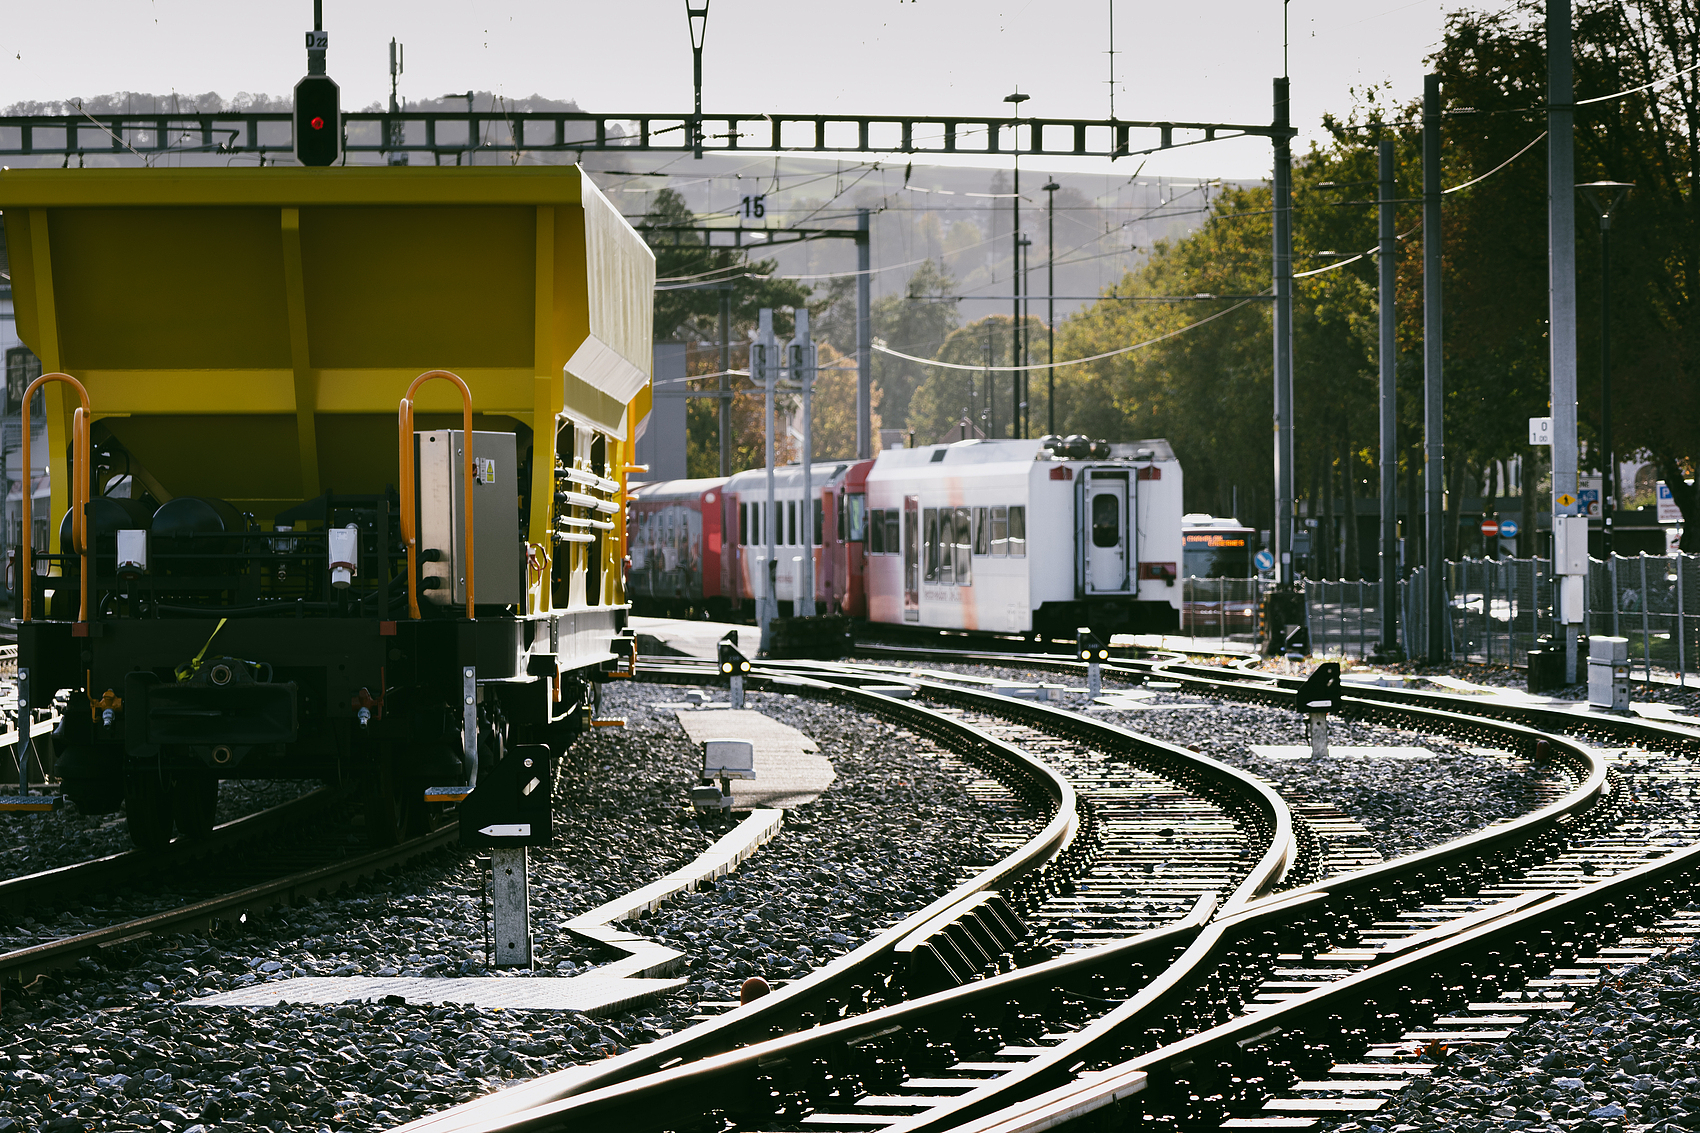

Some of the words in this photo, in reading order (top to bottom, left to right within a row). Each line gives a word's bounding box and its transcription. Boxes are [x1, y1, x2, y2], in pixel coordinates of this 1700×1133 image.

[306, 33, 315, 48] D
[316, 36, 328, 48] 22
[742, 196, 765, 218] 15
[1661, 487, 1670, 498] P
